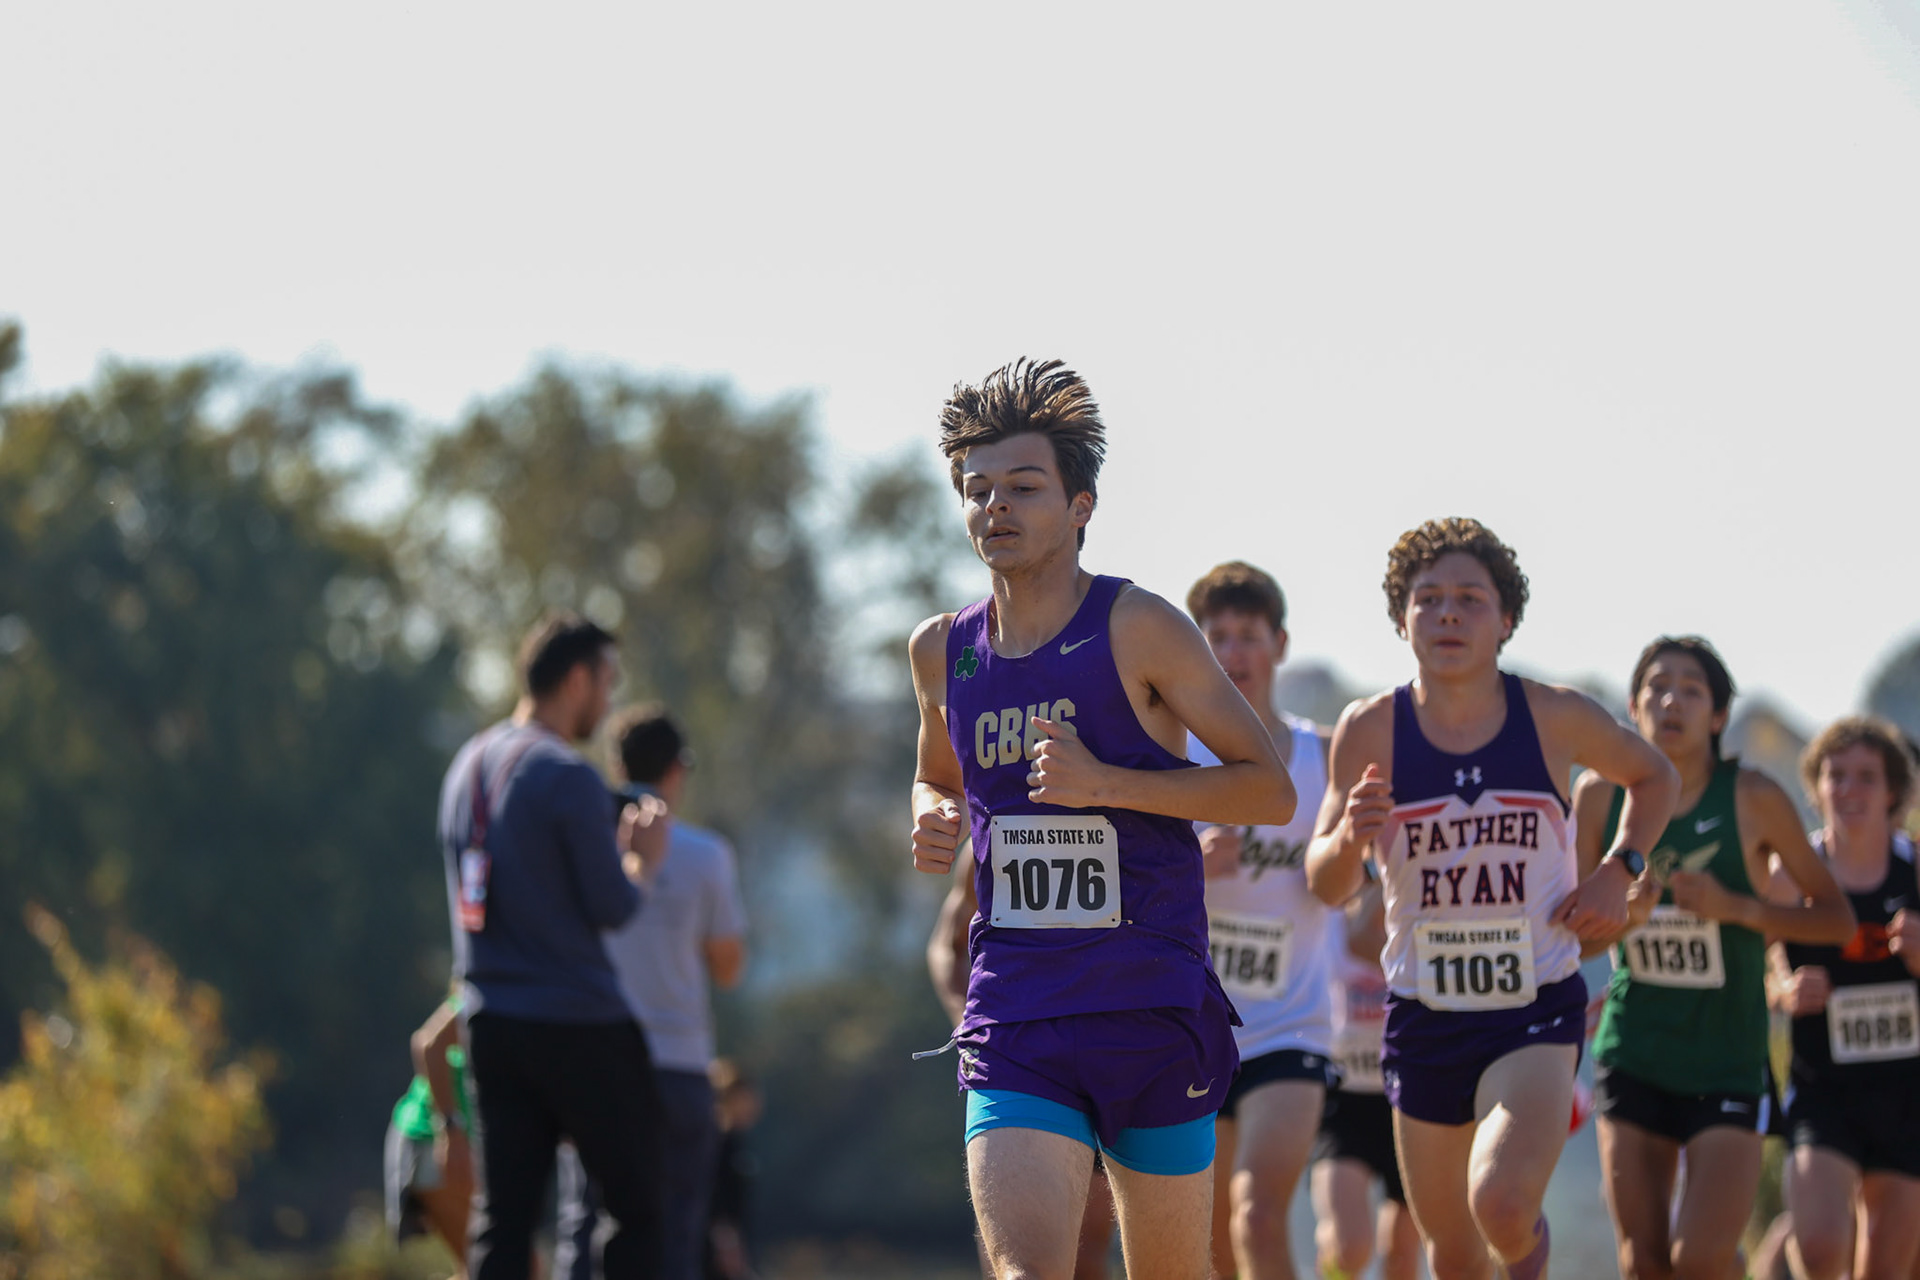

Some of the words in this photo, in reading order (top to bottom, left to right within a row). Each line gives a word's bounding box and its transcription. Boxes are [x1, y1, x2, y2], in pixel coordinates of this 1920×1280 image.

[1002, 829, 1045, 845] TMSAA
[1047, 829, 1085, 845] STATE
[1087, 829, 1104, 845] XC
[1405, 811, 1538, 859] FATHER
[1002, 858, 1107, 911] 1076
[1421, 861, 1526, 908] RYAN
[1468, 928, 1502, 944] STATE
[1636, 938, 1708, 973] 1139
[1428, 953, 1522, 995] 1103
